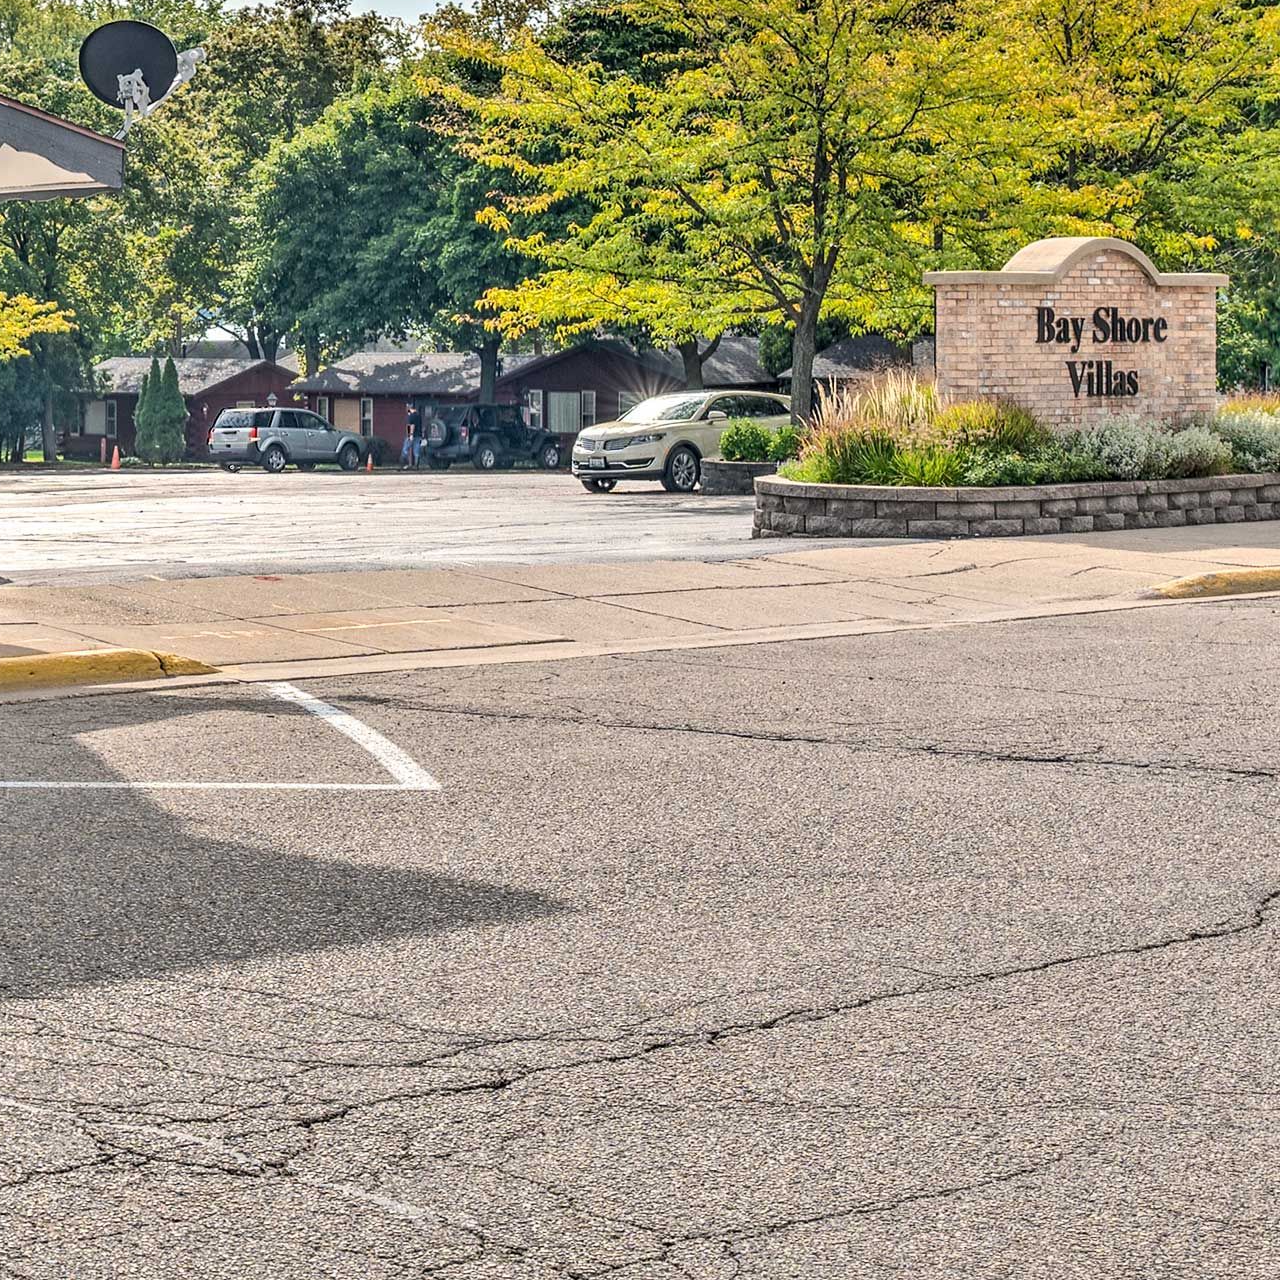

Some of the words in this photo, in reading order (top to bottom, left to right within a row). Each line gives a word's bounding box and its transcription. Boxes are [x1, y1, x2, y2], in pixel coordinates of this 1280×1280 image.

[1035, 306, 1086, 353] Bay
[1092, 306, 1168, 343] Shore
[1065, 360, 1139, 398] Villas
